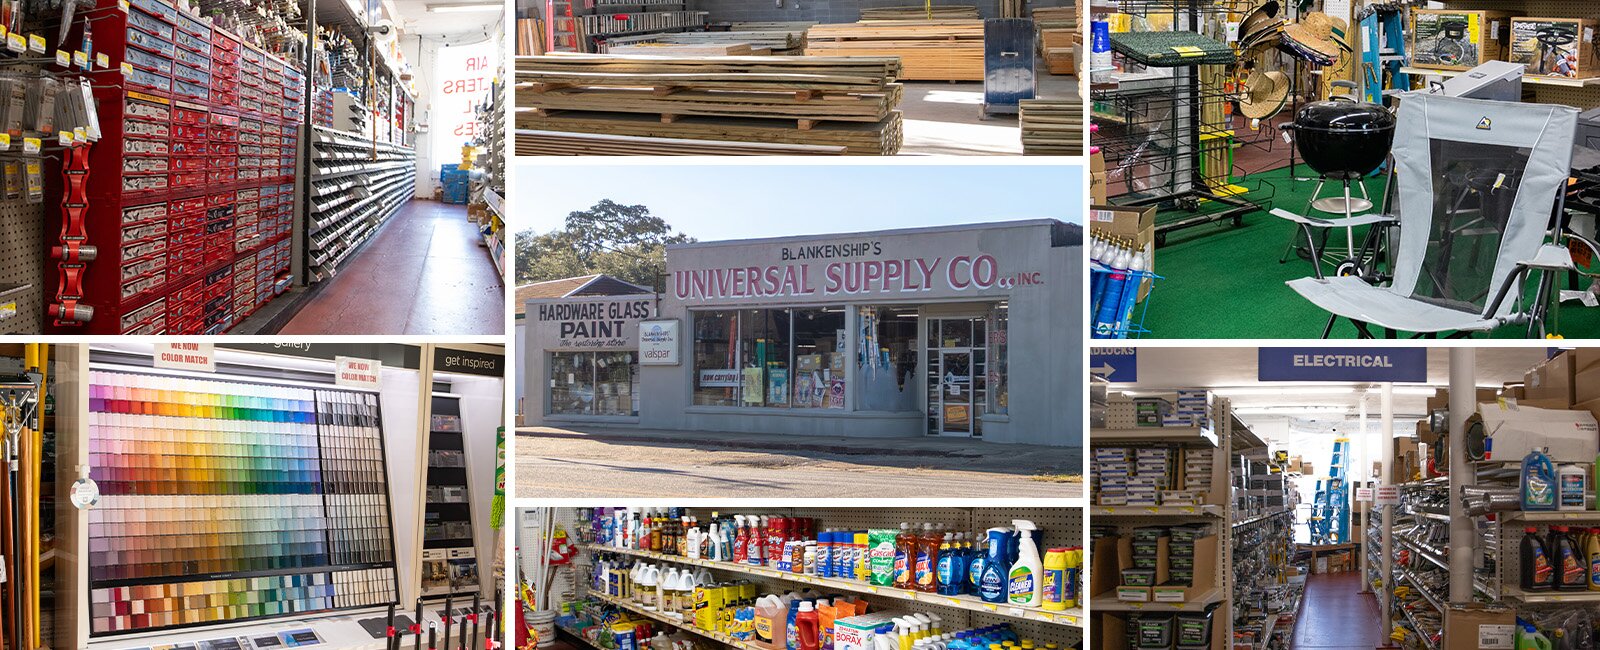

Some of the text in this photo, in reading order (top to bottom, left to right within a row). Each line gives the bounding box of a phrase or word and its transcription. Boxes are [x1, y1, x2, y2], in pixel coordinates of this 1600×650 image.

[781, 242, 882, 261] BLANKENSHIP'S
[675, 264, 816, 301] UNIVERSAL
[824, 257, 942, 296] SUPPLY
[1017, 272, 1044, 286] INC.
[539, 301, 650, 321] HARDWARE GLASS
[560, 321, 625, 338] PAINT
[183, 343, 199, 351] NOW
[1090, 347, 1135, 355] DLOCKS
[161, 352, 208, 365] COLOR MATCH
[644, 348, 670, 360] valspar
[357, 363, 370, 371] NOW
[446, 356, 495, 369] get inspired
[1293, 354, 1393, 368] ELECTRICAL
[341, 372, 377, 383] COLOR MATCH
[836, 632, 862, 647] BORAX
